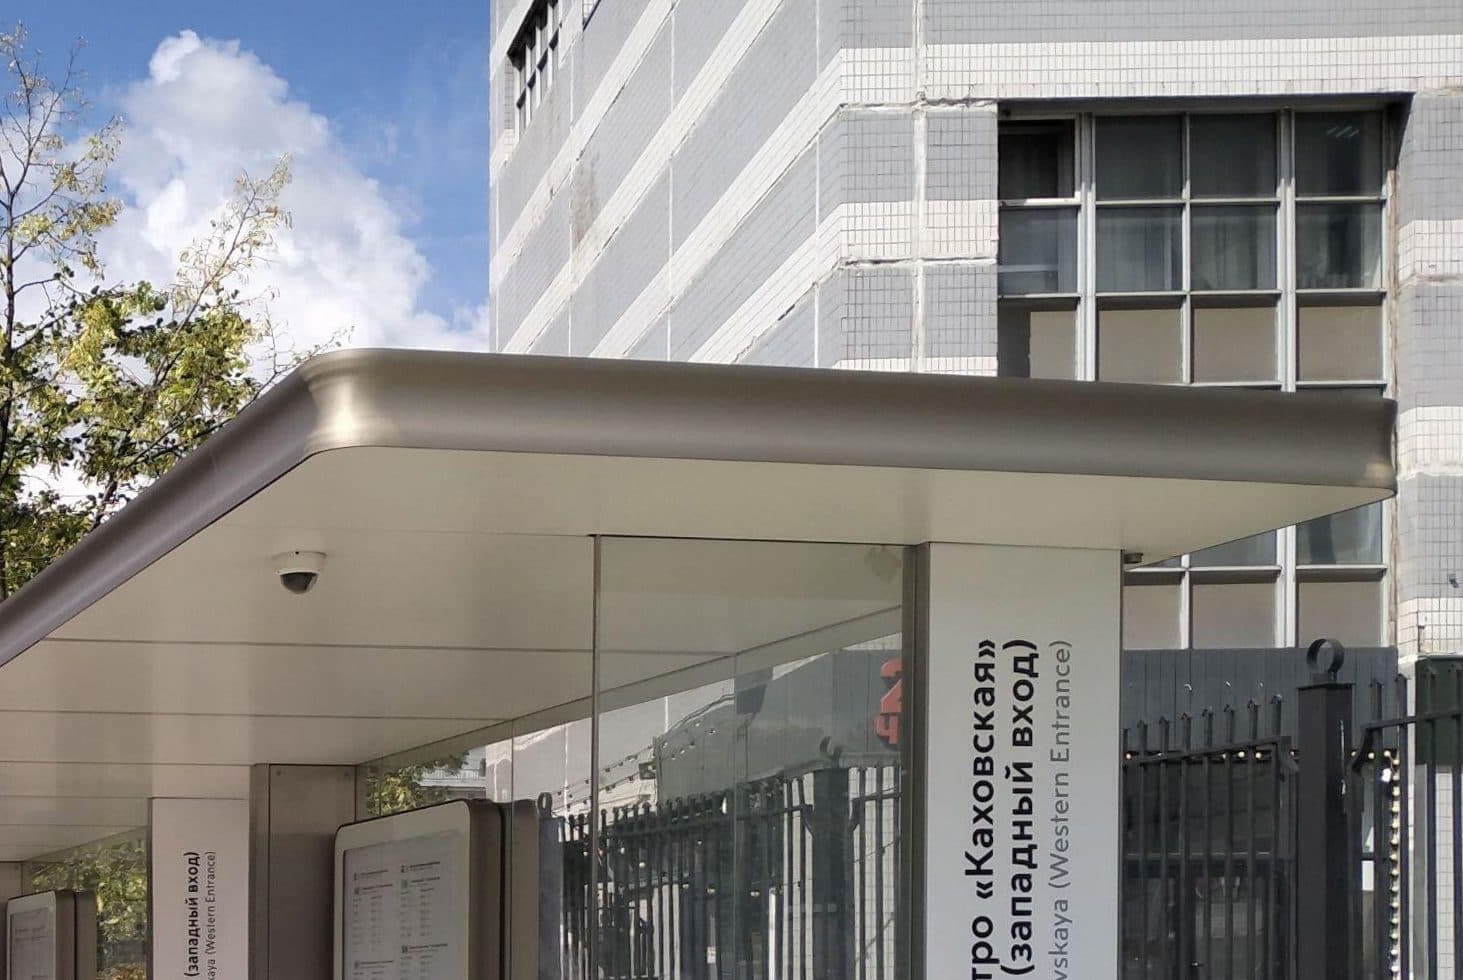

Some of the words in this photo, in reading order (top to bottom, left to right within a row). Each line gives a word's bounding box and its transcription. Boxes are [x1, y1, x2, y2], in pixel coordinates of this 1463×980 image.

[1002, 639, 1039, 747] вход)
[1047, 640, 1073, 763] Entrance)
[964, 638, 996, 900] «Каховская»
[183, 851, 201, 893] вход)
[205, 850, 217, 902] Entrance)
[1000, 761, 1039, 976] (западный
[1047, 772, 1073, 889] (Western
[183, 898, 201, 978] (западный
[204, 905, 217, 956] (Western
